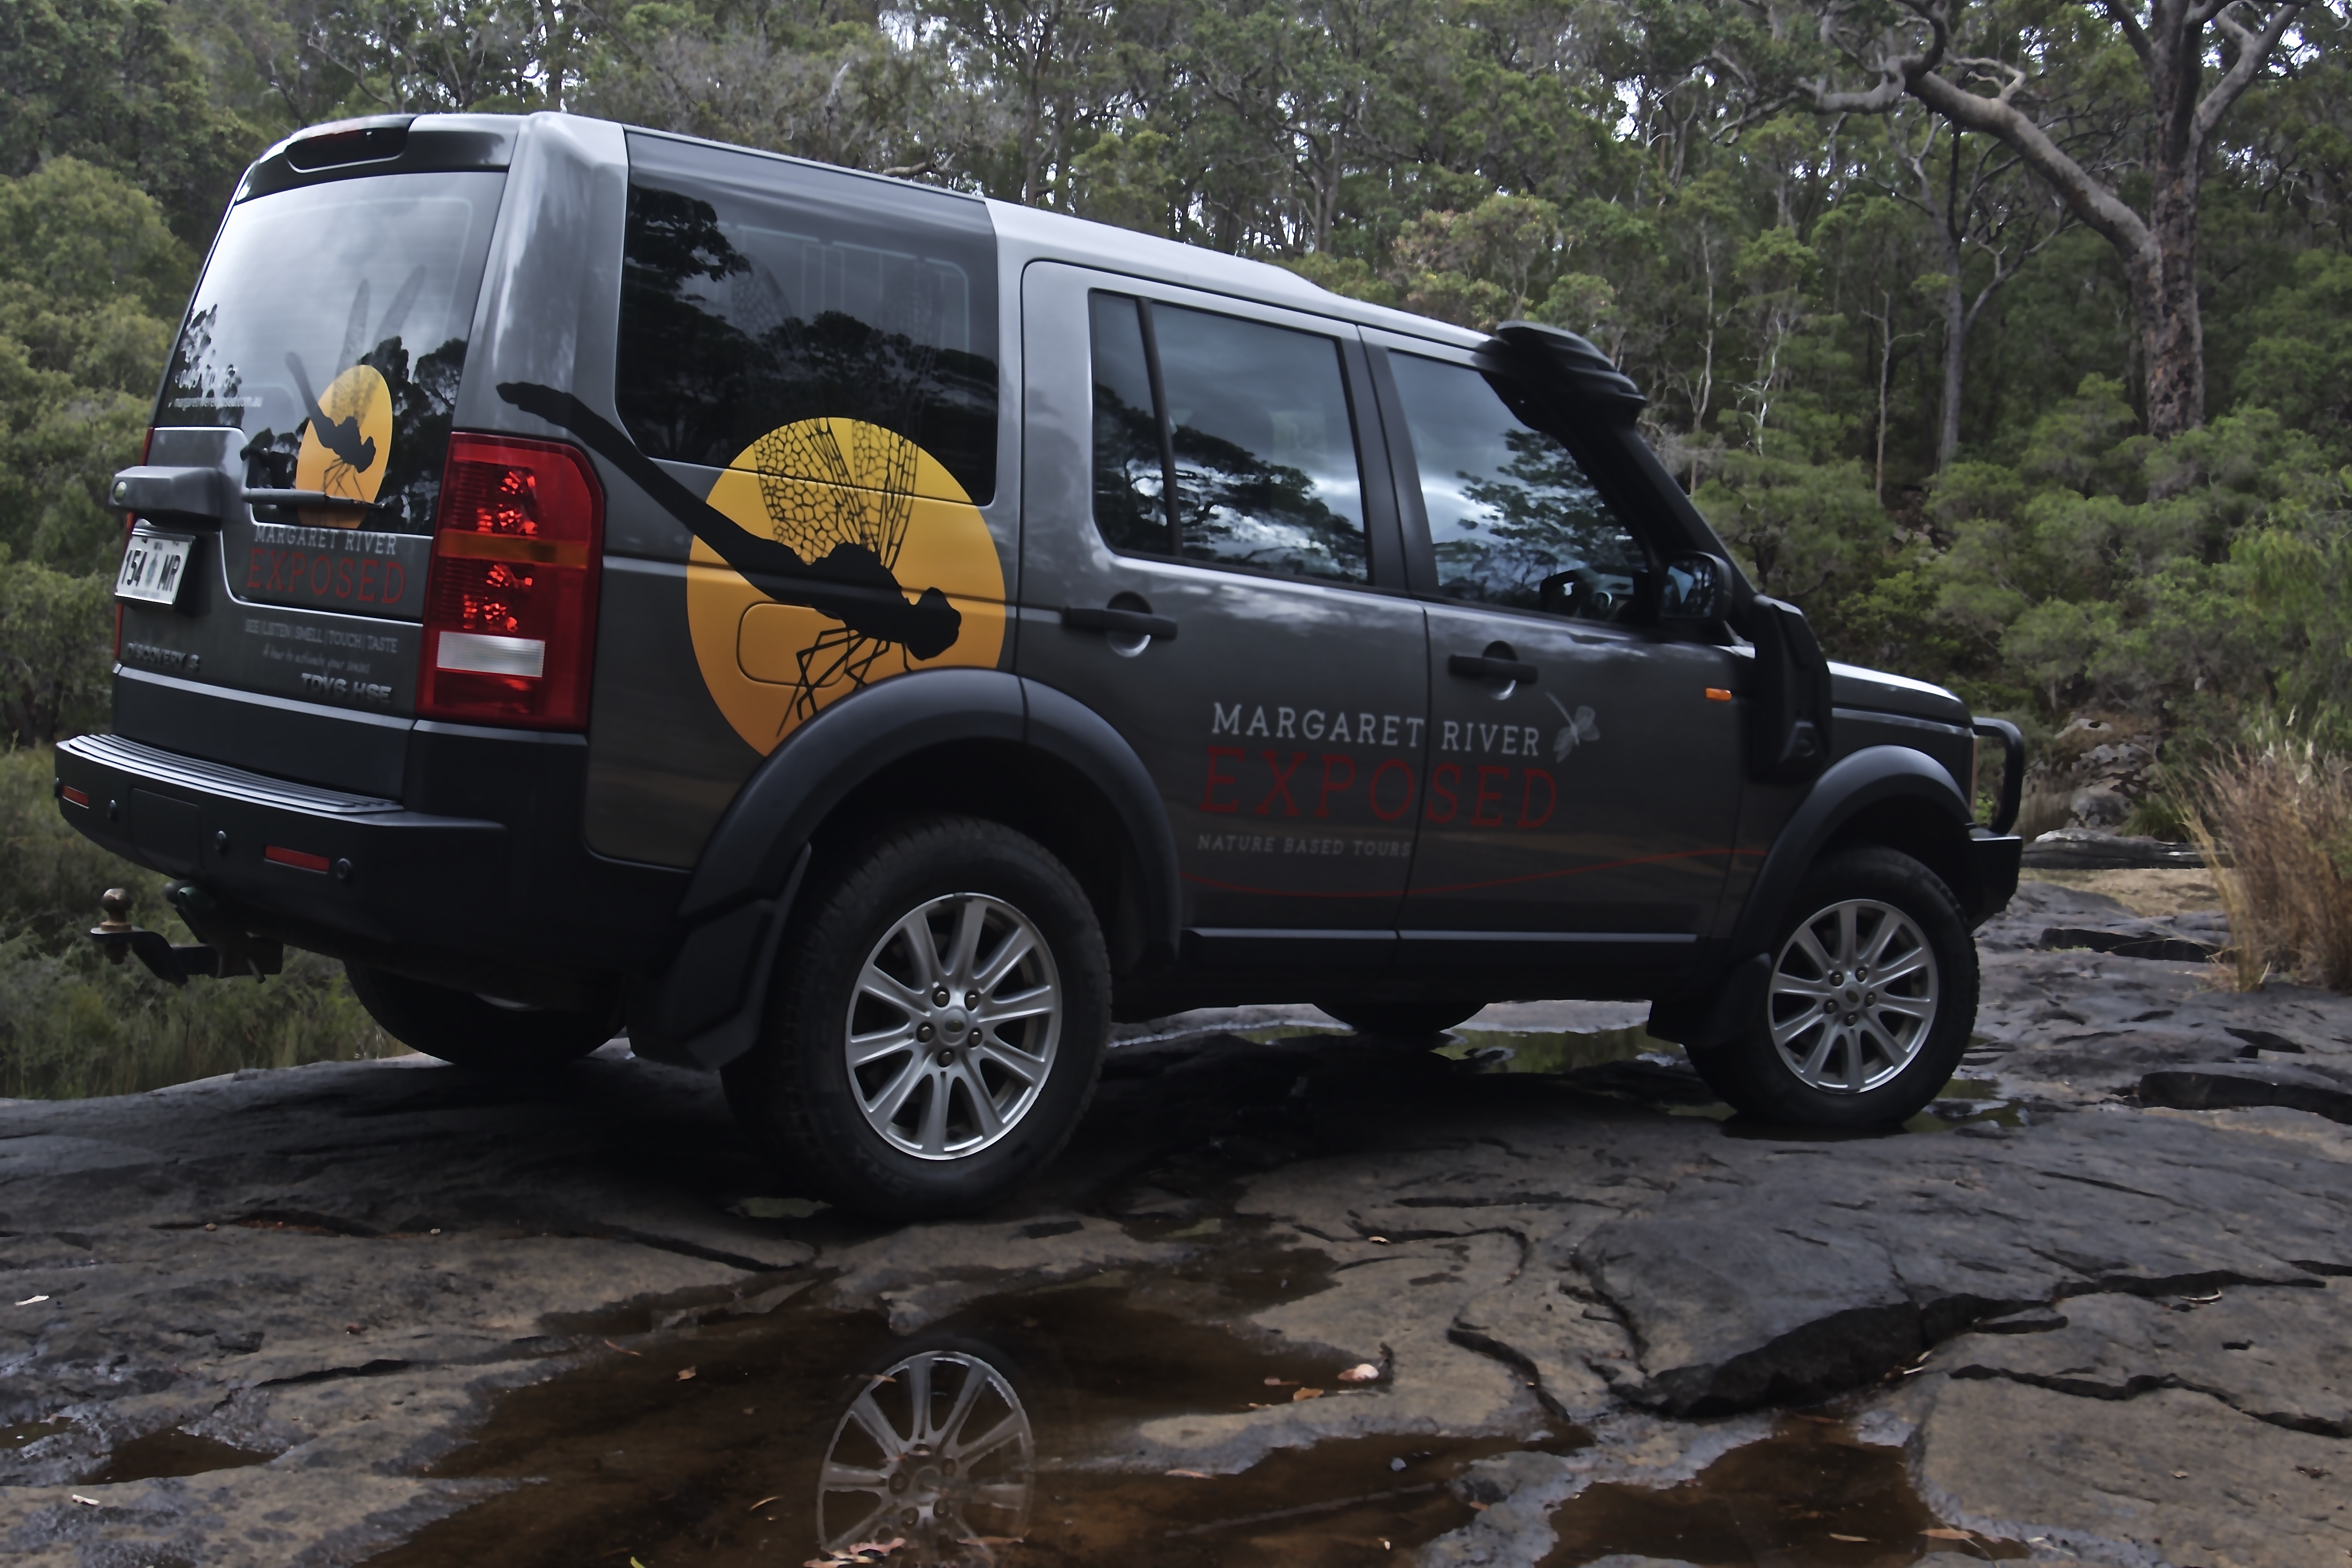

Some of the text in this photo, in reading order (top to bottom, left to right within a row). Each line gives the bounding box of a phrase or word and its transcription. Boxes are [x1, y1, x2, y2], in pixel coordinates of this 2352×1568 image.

[254, 525, 397, 555] MARGARET RIVER
[121, 549, 181, 592] 154 MR
[247, 548, 405, 604] EXPOSED
[245, 619, 398, 653] SEE LISTEN SMELL TOUCH TASTE
[128, 643, 187, 667] DISCOVERY
[354, 681, 393, 703] HSE
[1212, 703, 1540, 756] MARGARET RIVER
[1198, 746, 1557, 828] EXPOSED
[1197, 834, 1411, 857] NATURE BASED TOURS
